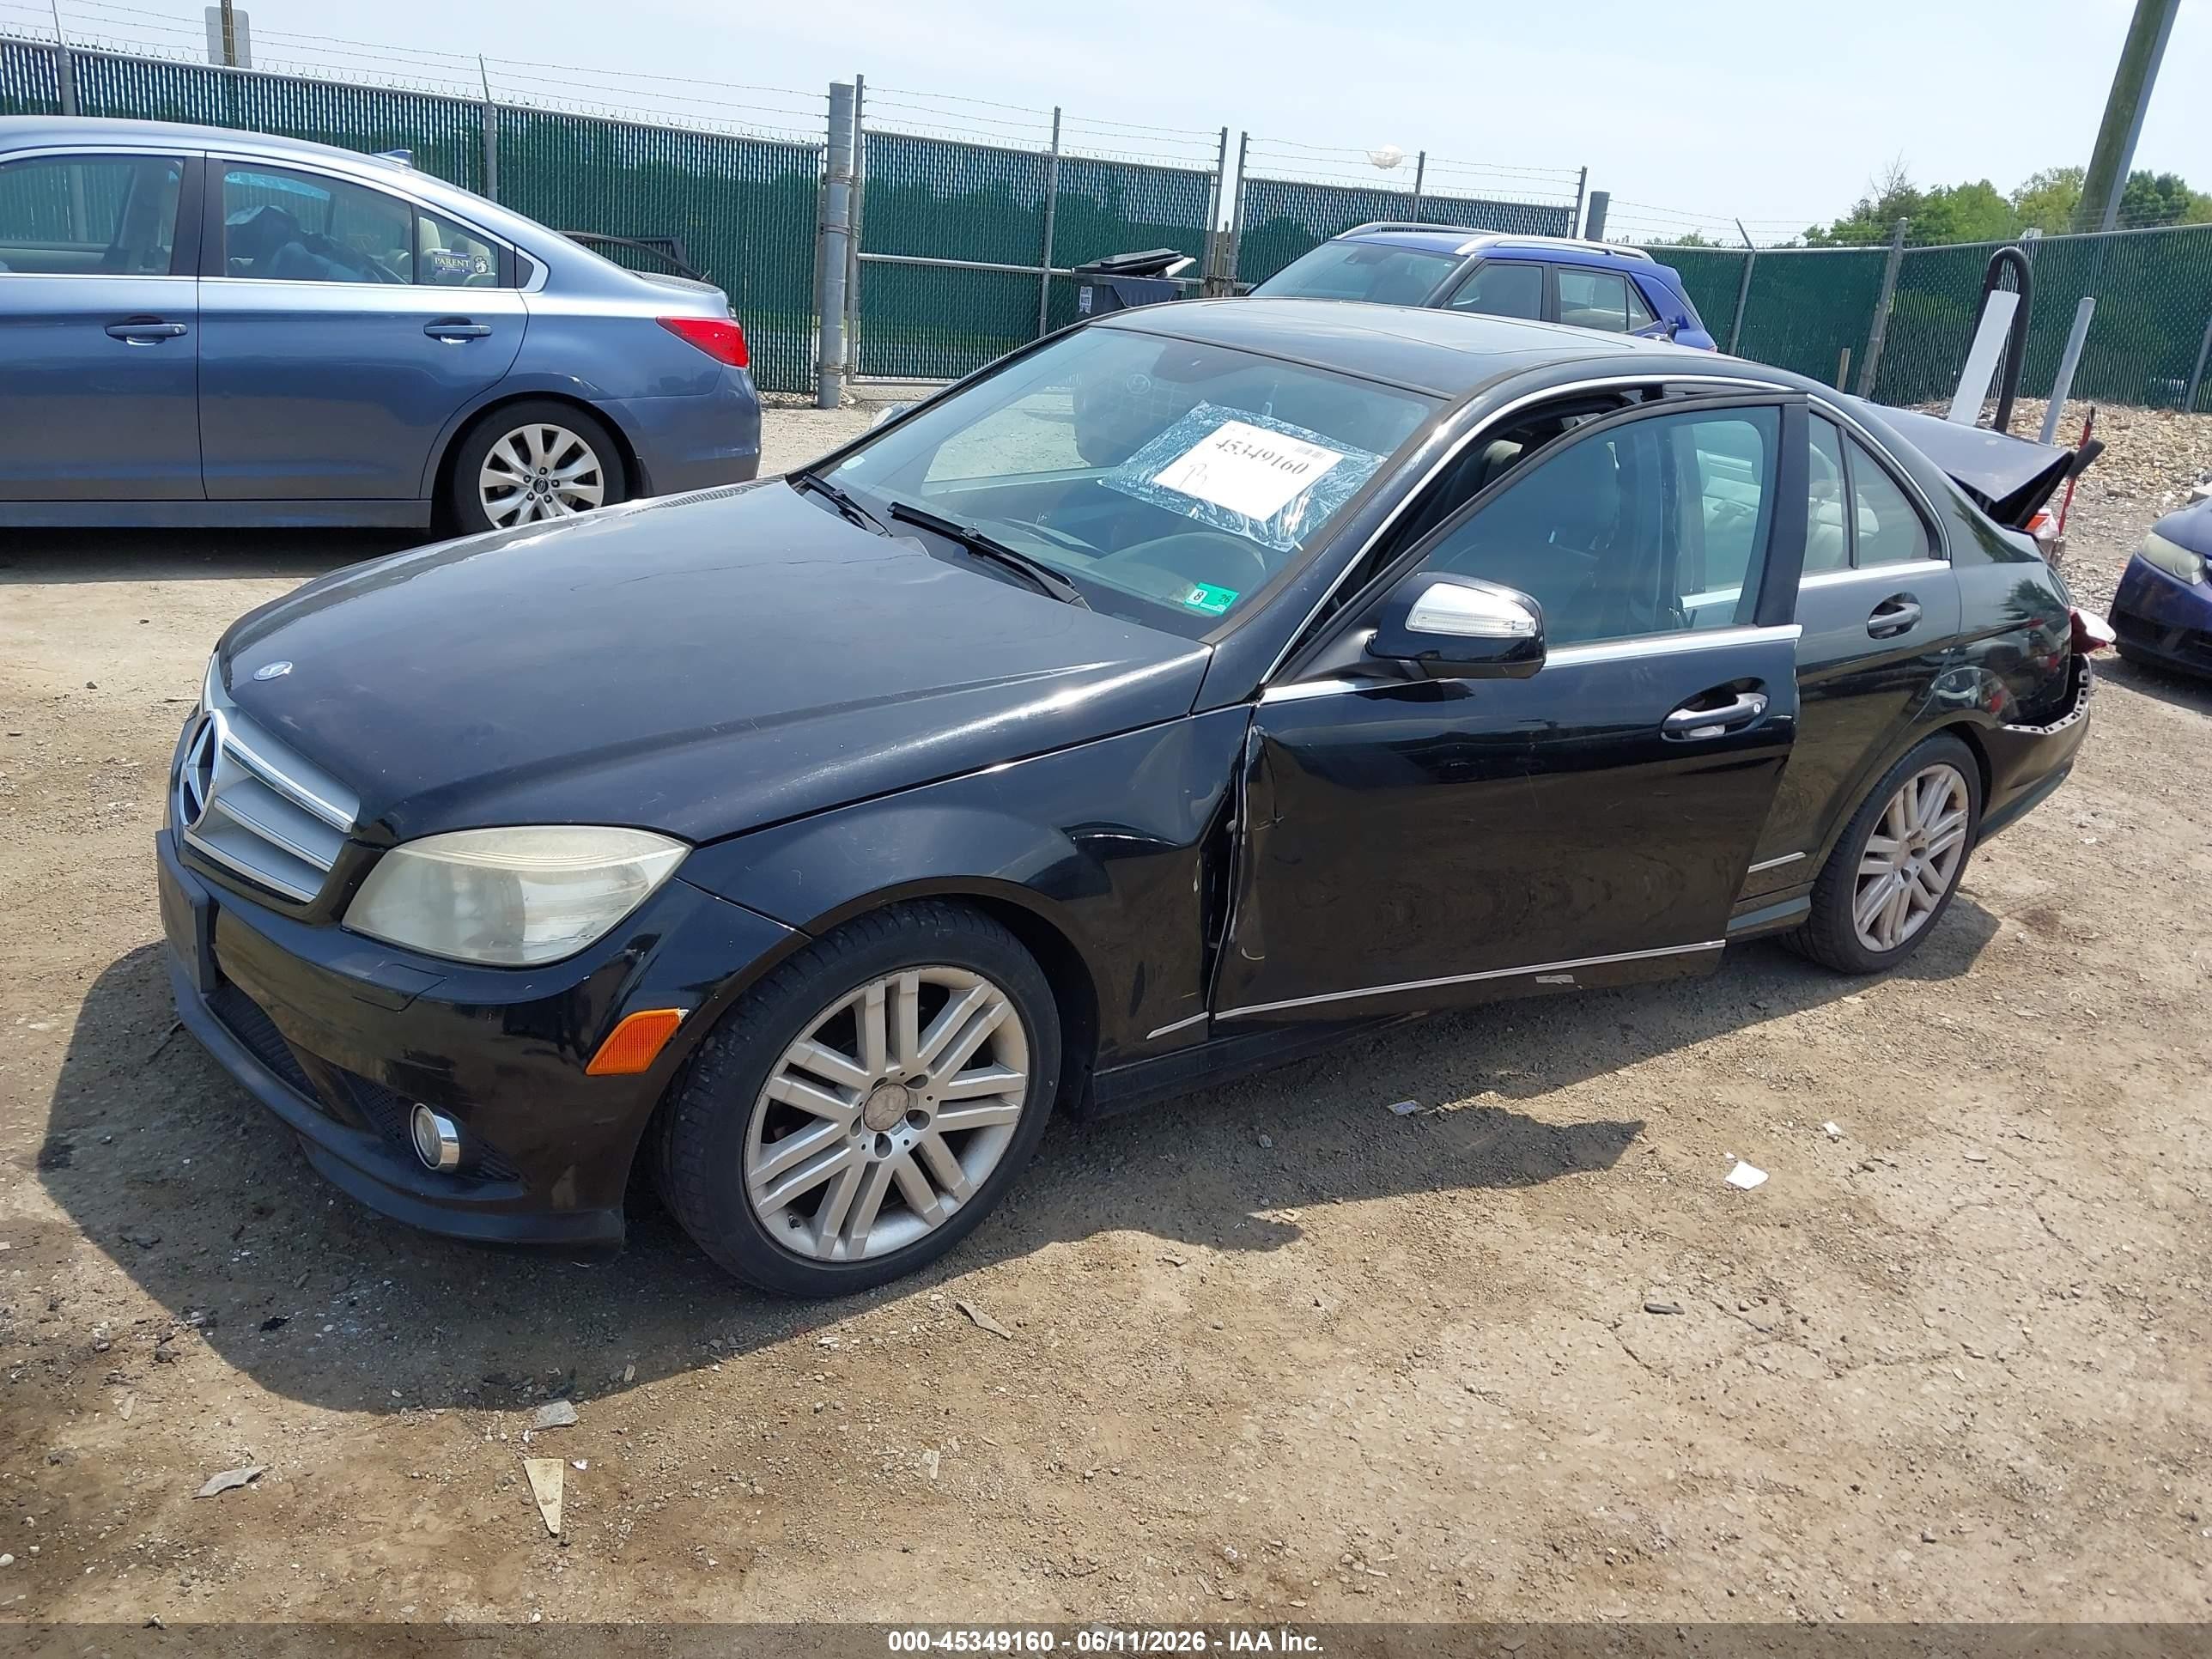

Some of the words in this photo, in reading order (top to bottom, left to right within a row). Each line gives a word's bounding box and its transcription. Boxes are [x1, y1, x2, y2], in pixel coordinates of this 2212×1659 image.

[434, 257, 470, 267] PARENT
[1215, 439, 1310, 475] 45349160
[1194, 591, 1204, 601] 8
[1218, 593, 1232, 604] 26
